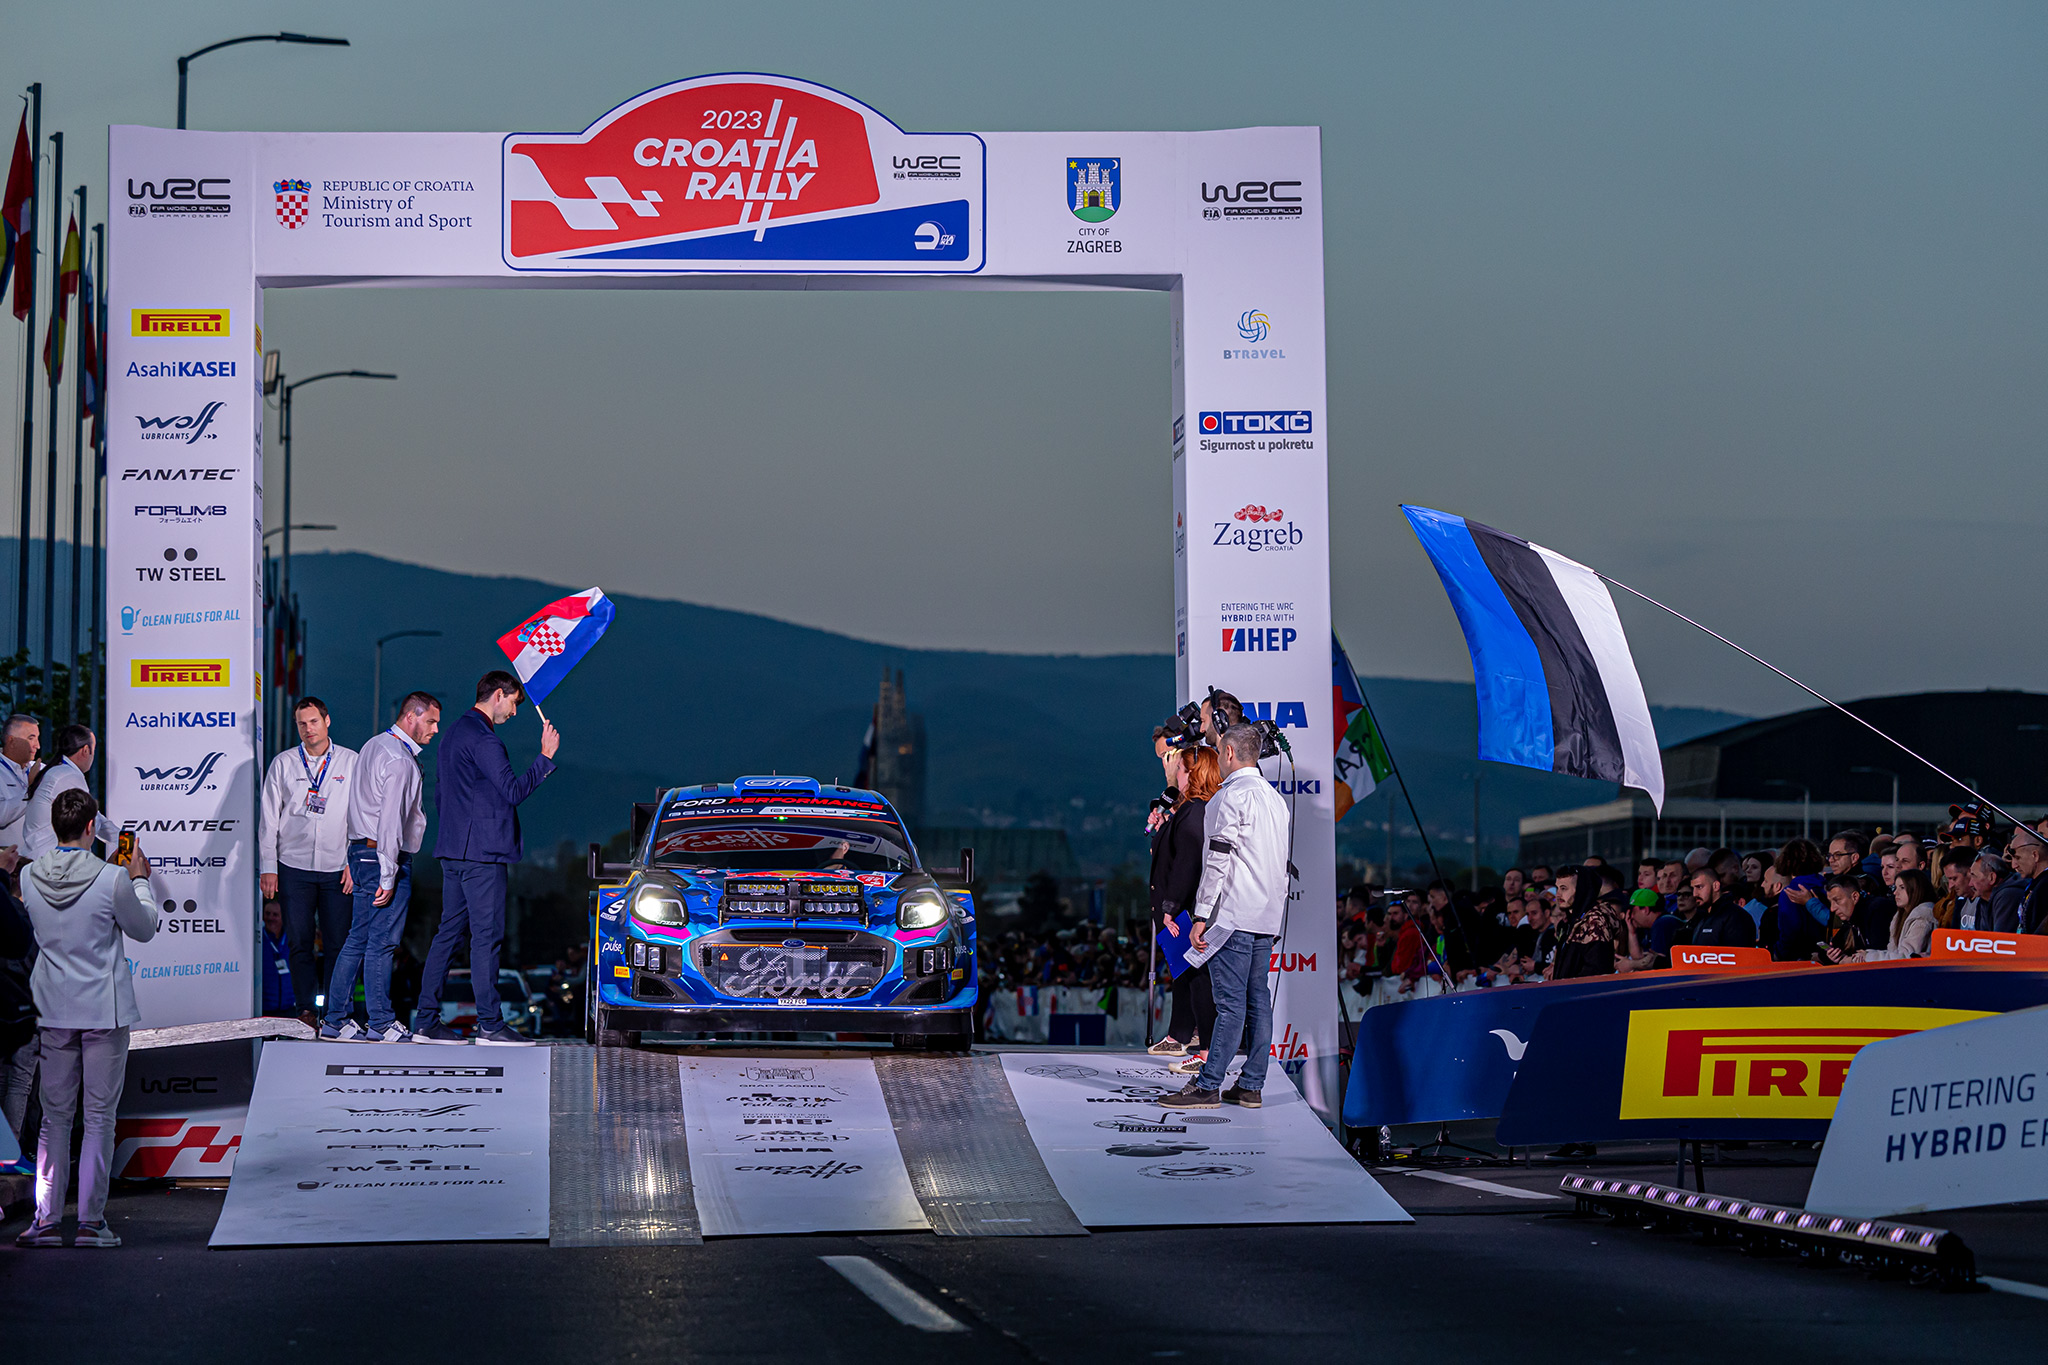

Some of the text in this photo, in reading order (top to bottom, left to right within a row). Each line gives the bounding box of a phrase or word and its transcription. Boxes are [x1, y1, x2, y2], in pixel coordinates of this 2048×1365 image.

[701, 110, 762, 129] 2023
[633, 132, 819, 171] CROATIA
[893, 156, 961, 169] WRC
[128, 178, 231, 199] WRC
[323, 181, 475, 191] REPUBLIC OF CROATIA
[685, 172, 816, 201] RALLY
[1202, 181, 1302, 202] WRC
[128, 205, 147, 216] FIA
[323, 196, 415, 213] Ministry of
[1203, 209, 1221, 218] FIA
[323, 214, 472, 231] Tourism and Sport
[1079, 228, 1109, 236] CITY OF
[1067, 241, 1122, 253] ZAGREB
[141, 314, 222, 332] PIRELLI
[1225, 411, 1309, 432] TOKIĆ
[1200, 439, 1314, 453] Sigurnost u pokretu
[122, 469, 236, 481] FANATEC
[134, 506, 227, 516] FORUM8
[1213, 521, 1303, 552] Zagreb
[136, 567, 226, 581] TW STEEL
[1221, 602, 1294, 611] ENTERING THE WRC
[142, 609, 240, 627] CLEAN FUELS FOR ALL
[1221, 613, 1295, 622] HYBRID ERA WITH
[1248, 628, 1297, 651] HEP
[141, 664, 222, 682] PIRELLI
[1241, 702, 1308, 728] NA
[671, 797, 884, 810] FORD PERFORMANCE
[669, 808, 753, 817] BEYOND
[148, 857, 227, 867] ORUM8
[169, 919, 225, 933] STEEL
[1946, 936, 2017, 955] WRC
[1269, 952, 1317, 972] ZUM
[1682, 952, 1736, 965] WRC
[141, 961, 240, 979] CLEAN FUELS FOR ALL
[141, 1077, 218, 1094] WRC
[1890, 1073, 2036, 1116] ENTERING
[1886, 1123, 2006, 1163] HYBRID
